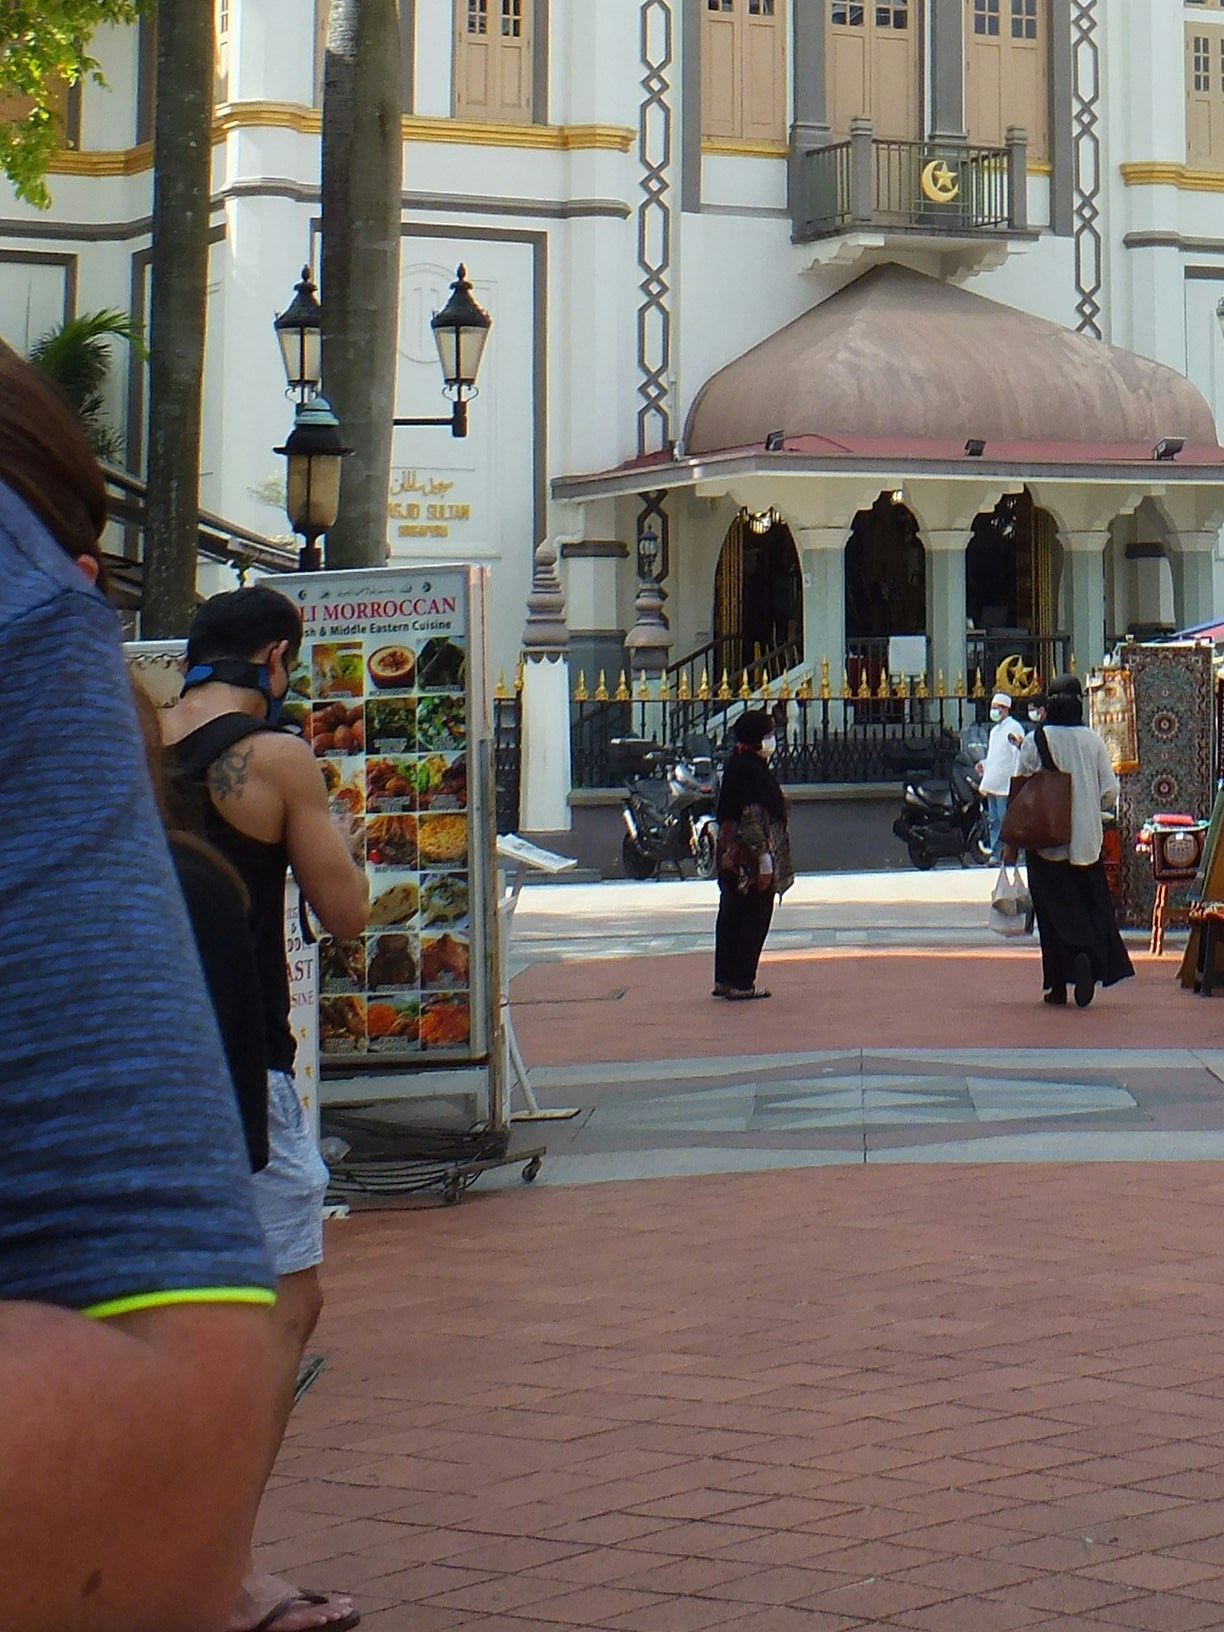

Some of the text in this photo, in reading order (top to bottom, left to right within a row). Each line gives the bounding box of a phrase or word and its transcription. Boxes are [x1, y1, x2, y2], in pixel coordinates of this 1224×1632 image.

[323, 597, 457, 622] MORROCCAN
[319, 627, 327, 637] &
[330, 624, 367, 637] Middle
[370, 621, 410, 634] Eastern
[412, 618, 452, 631] Cuisine
